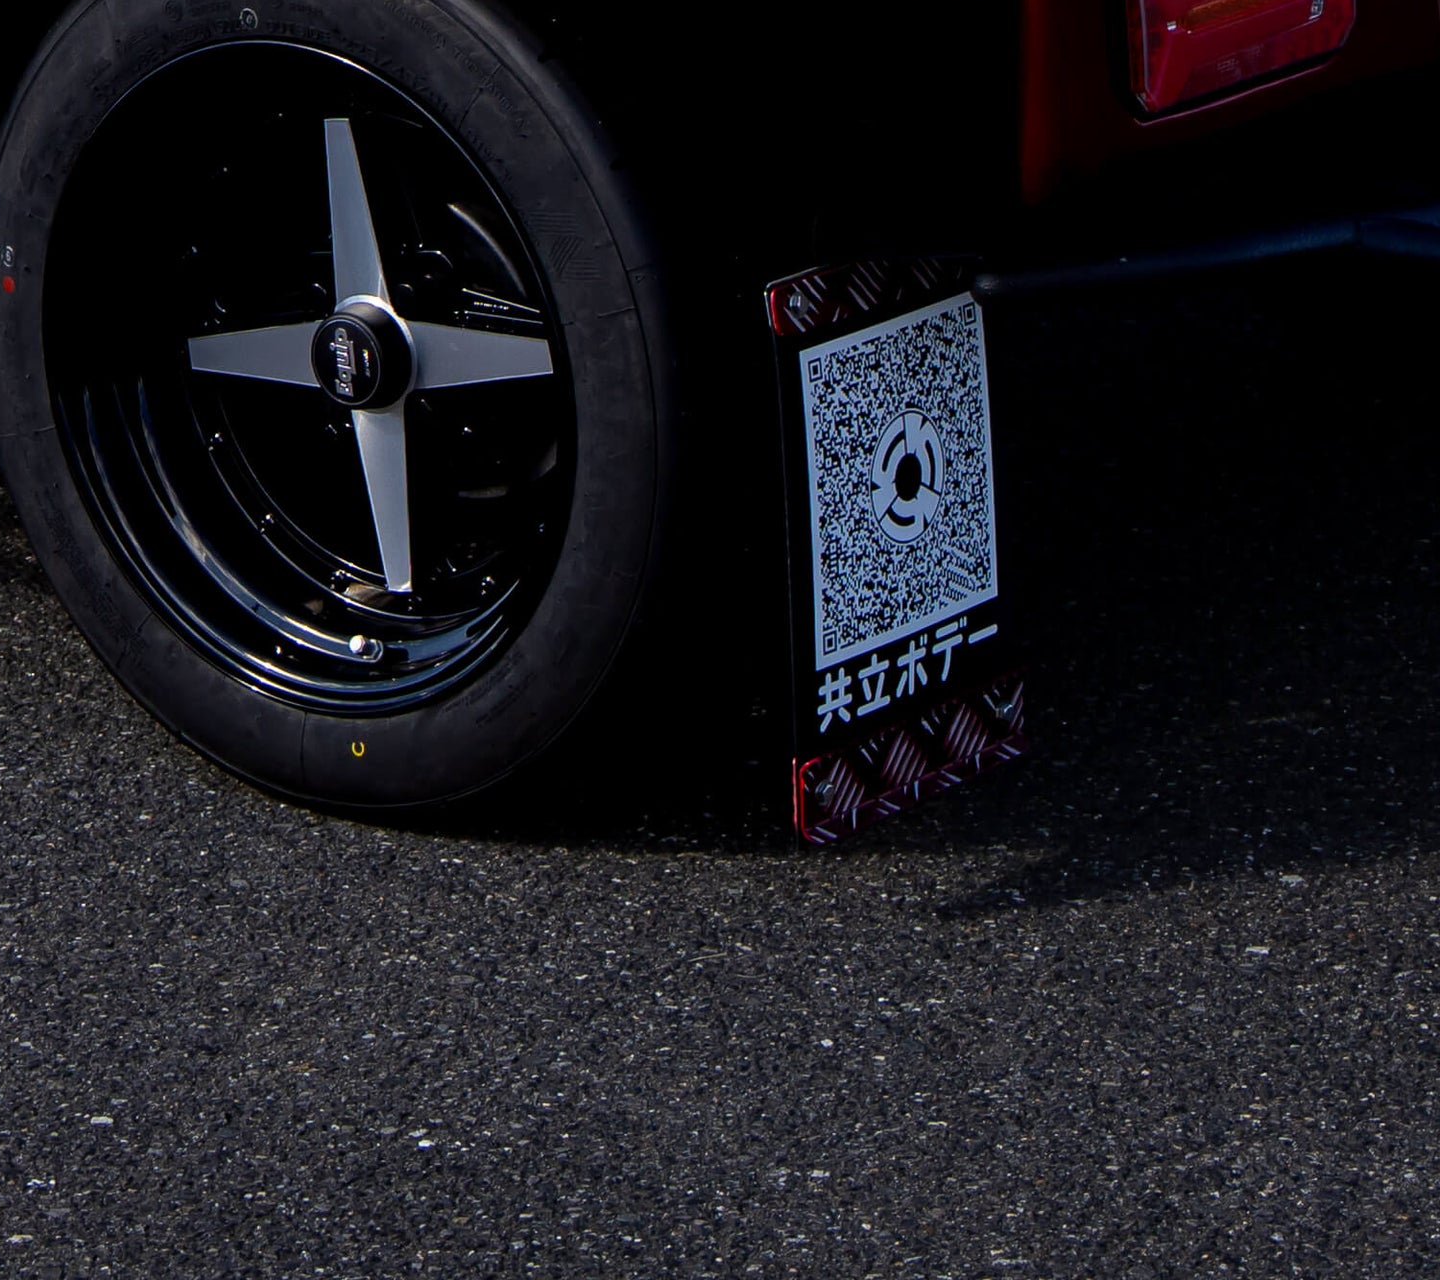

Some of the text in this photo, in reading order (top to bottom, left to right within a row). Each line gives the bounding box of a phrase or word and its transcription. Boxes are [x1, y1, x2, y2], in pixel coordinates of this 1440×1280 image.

[817, 623, 999, 733] 共立ボデー
